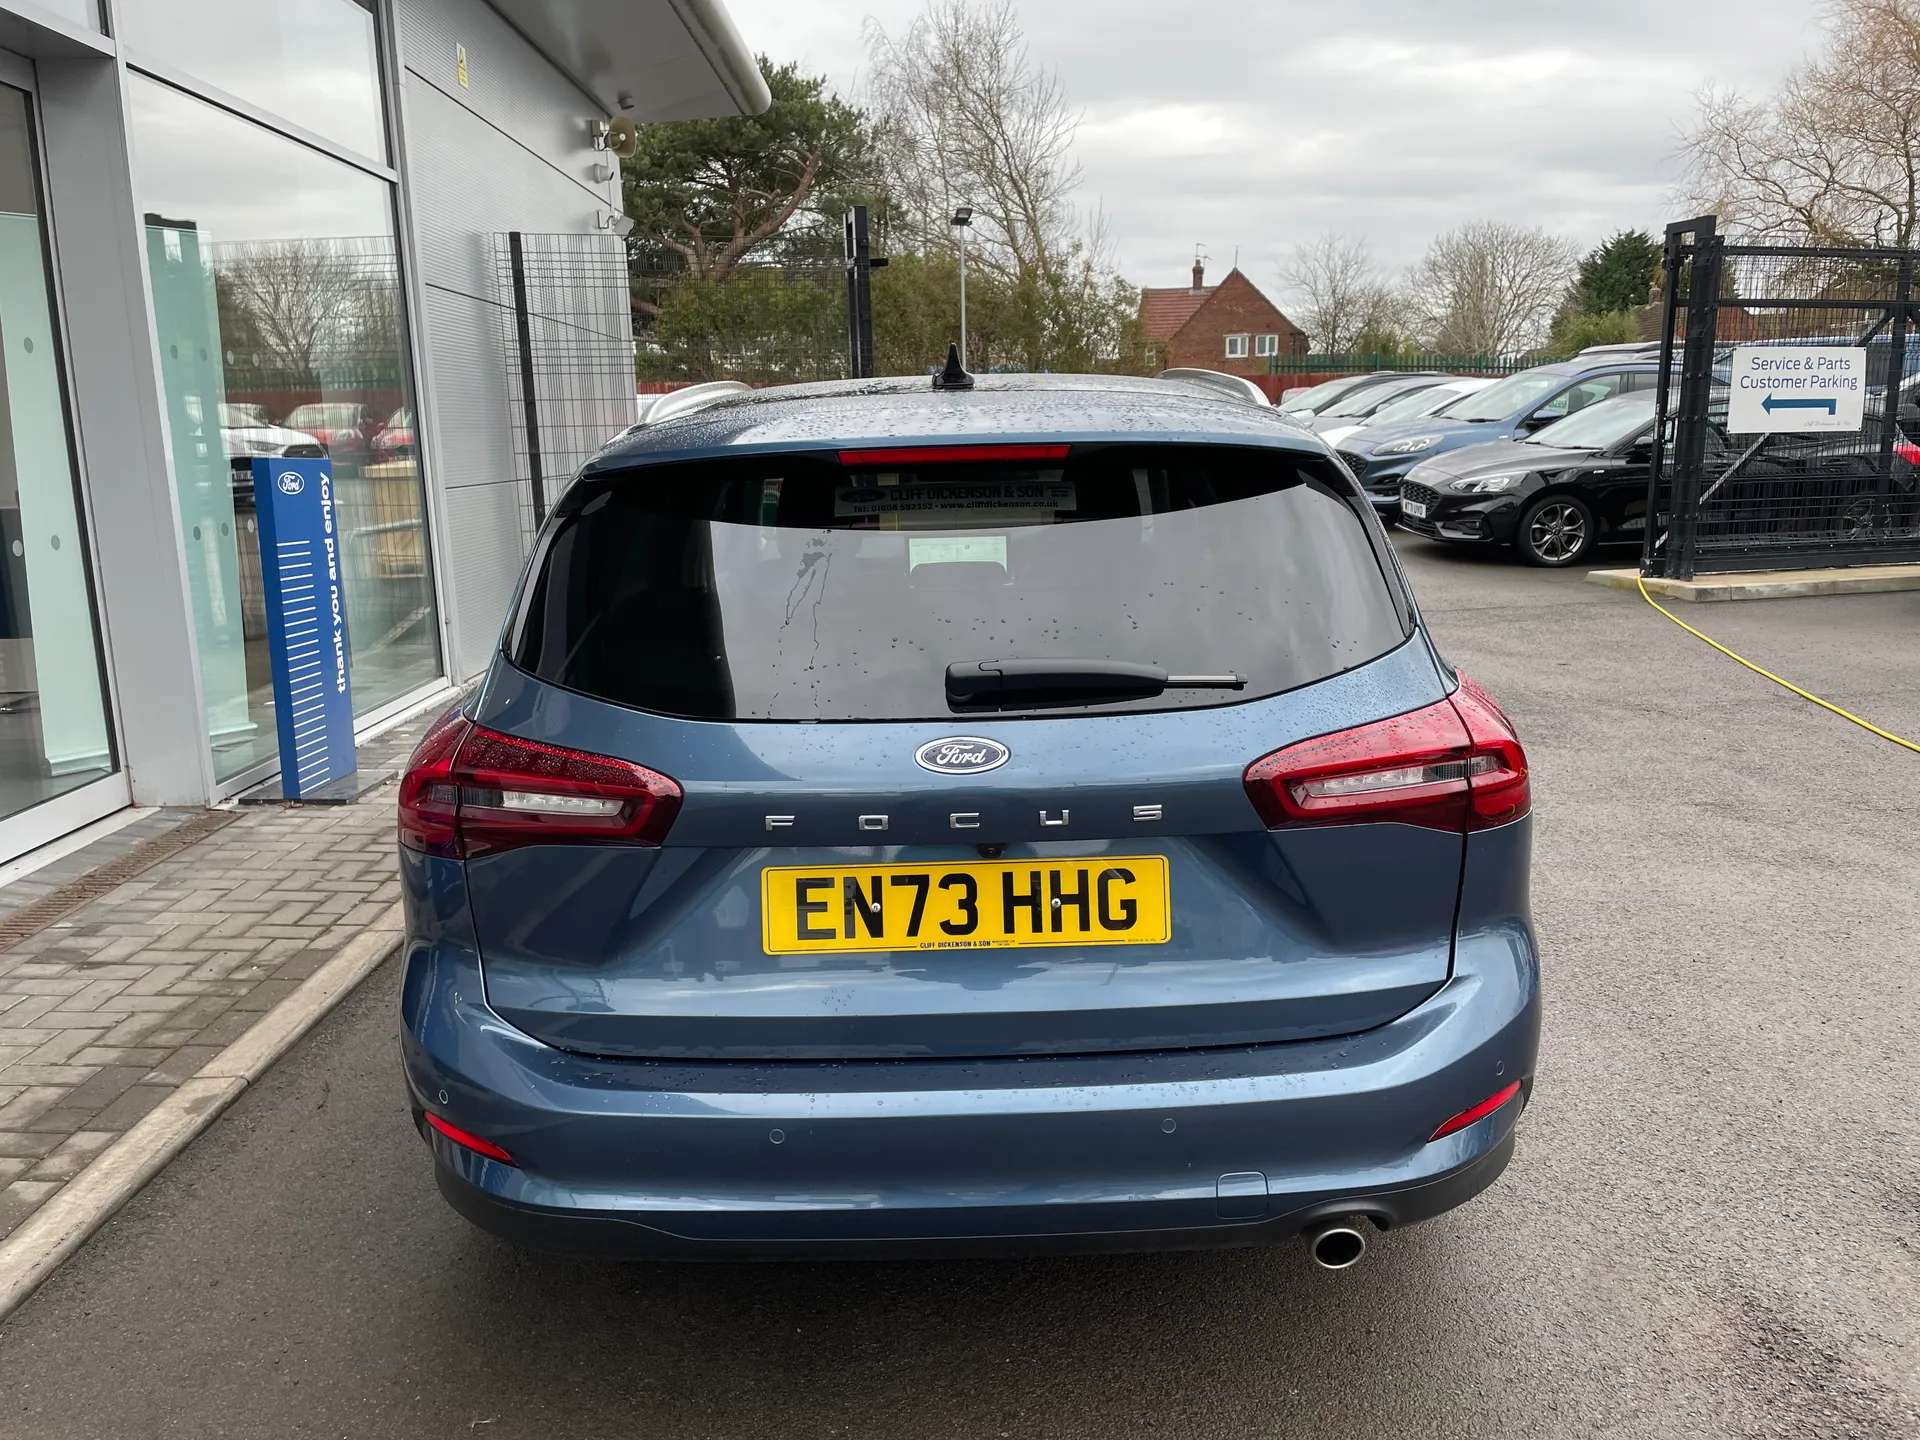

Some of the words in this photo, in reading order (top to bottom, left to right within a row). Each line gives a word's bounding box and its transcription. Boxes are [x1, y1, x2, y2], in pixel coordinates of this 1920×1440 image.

[1740, 375, 1807, 389] Customer
[1810, 375, 1858, 391] Parking
[1751, 357, 1801, 370] Service
[1803, 357, 1814, 370] &
[1817, 357, 1851, 370] Parts
[319, 471, 333, 533] enjoy
[890, 488, 925, 501] CLIFF
[927, 486, 1002, 500] DICKENSON
[1004, 486, 1015, 498] &
[1017, 485, 1044, 498] SON
[323, 539, 337, 581] and
[332, 585, 342, 626] you
[332, 630, 346, 694] thank
[765, 804, 1163, 832] FOCUS
[796, 873, 979, 941] EN73
[1002, 867, 1138, 935] HHG
